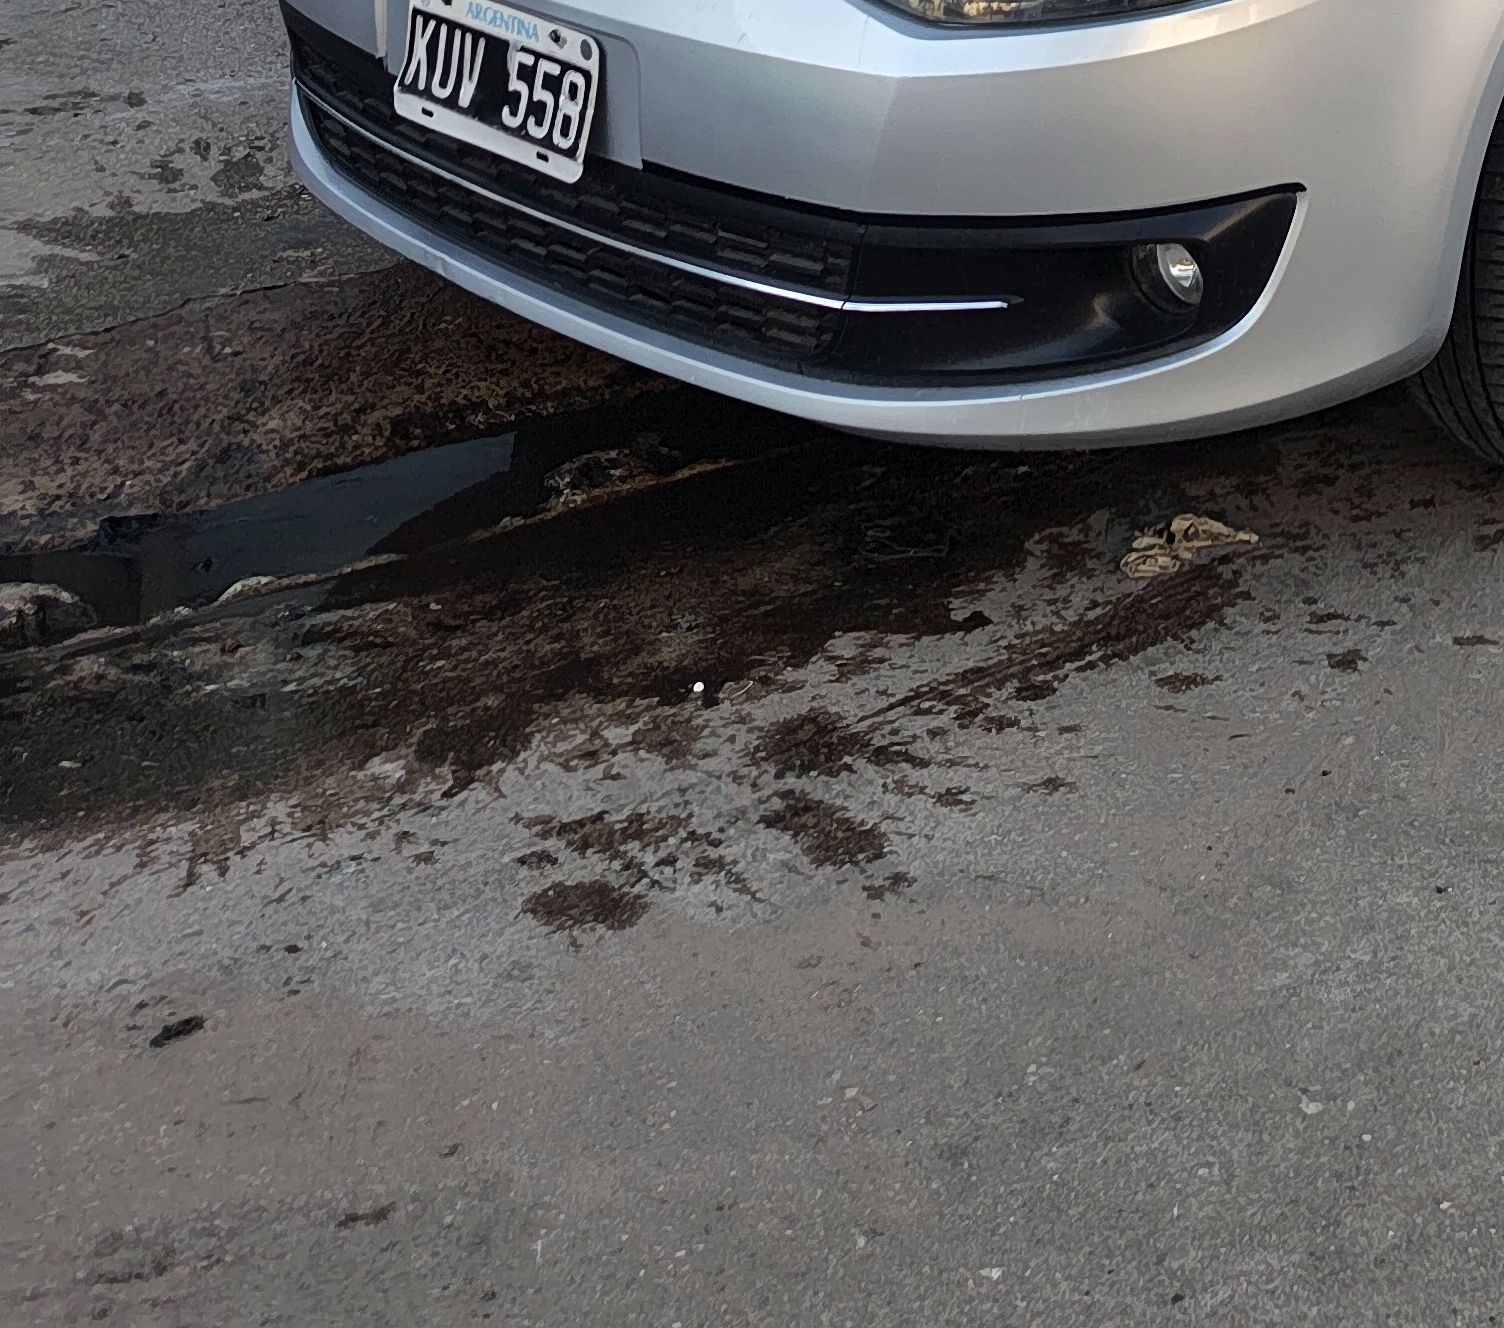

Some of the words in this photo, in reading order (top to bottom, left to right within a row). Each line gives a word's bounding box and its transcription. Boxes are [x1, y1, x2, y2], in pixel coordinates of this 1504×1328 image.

[465, 0, 540, 43] ARGENTINA
[403, 14, 486, 109] KUV
[501, 52, 587, 150] 558
